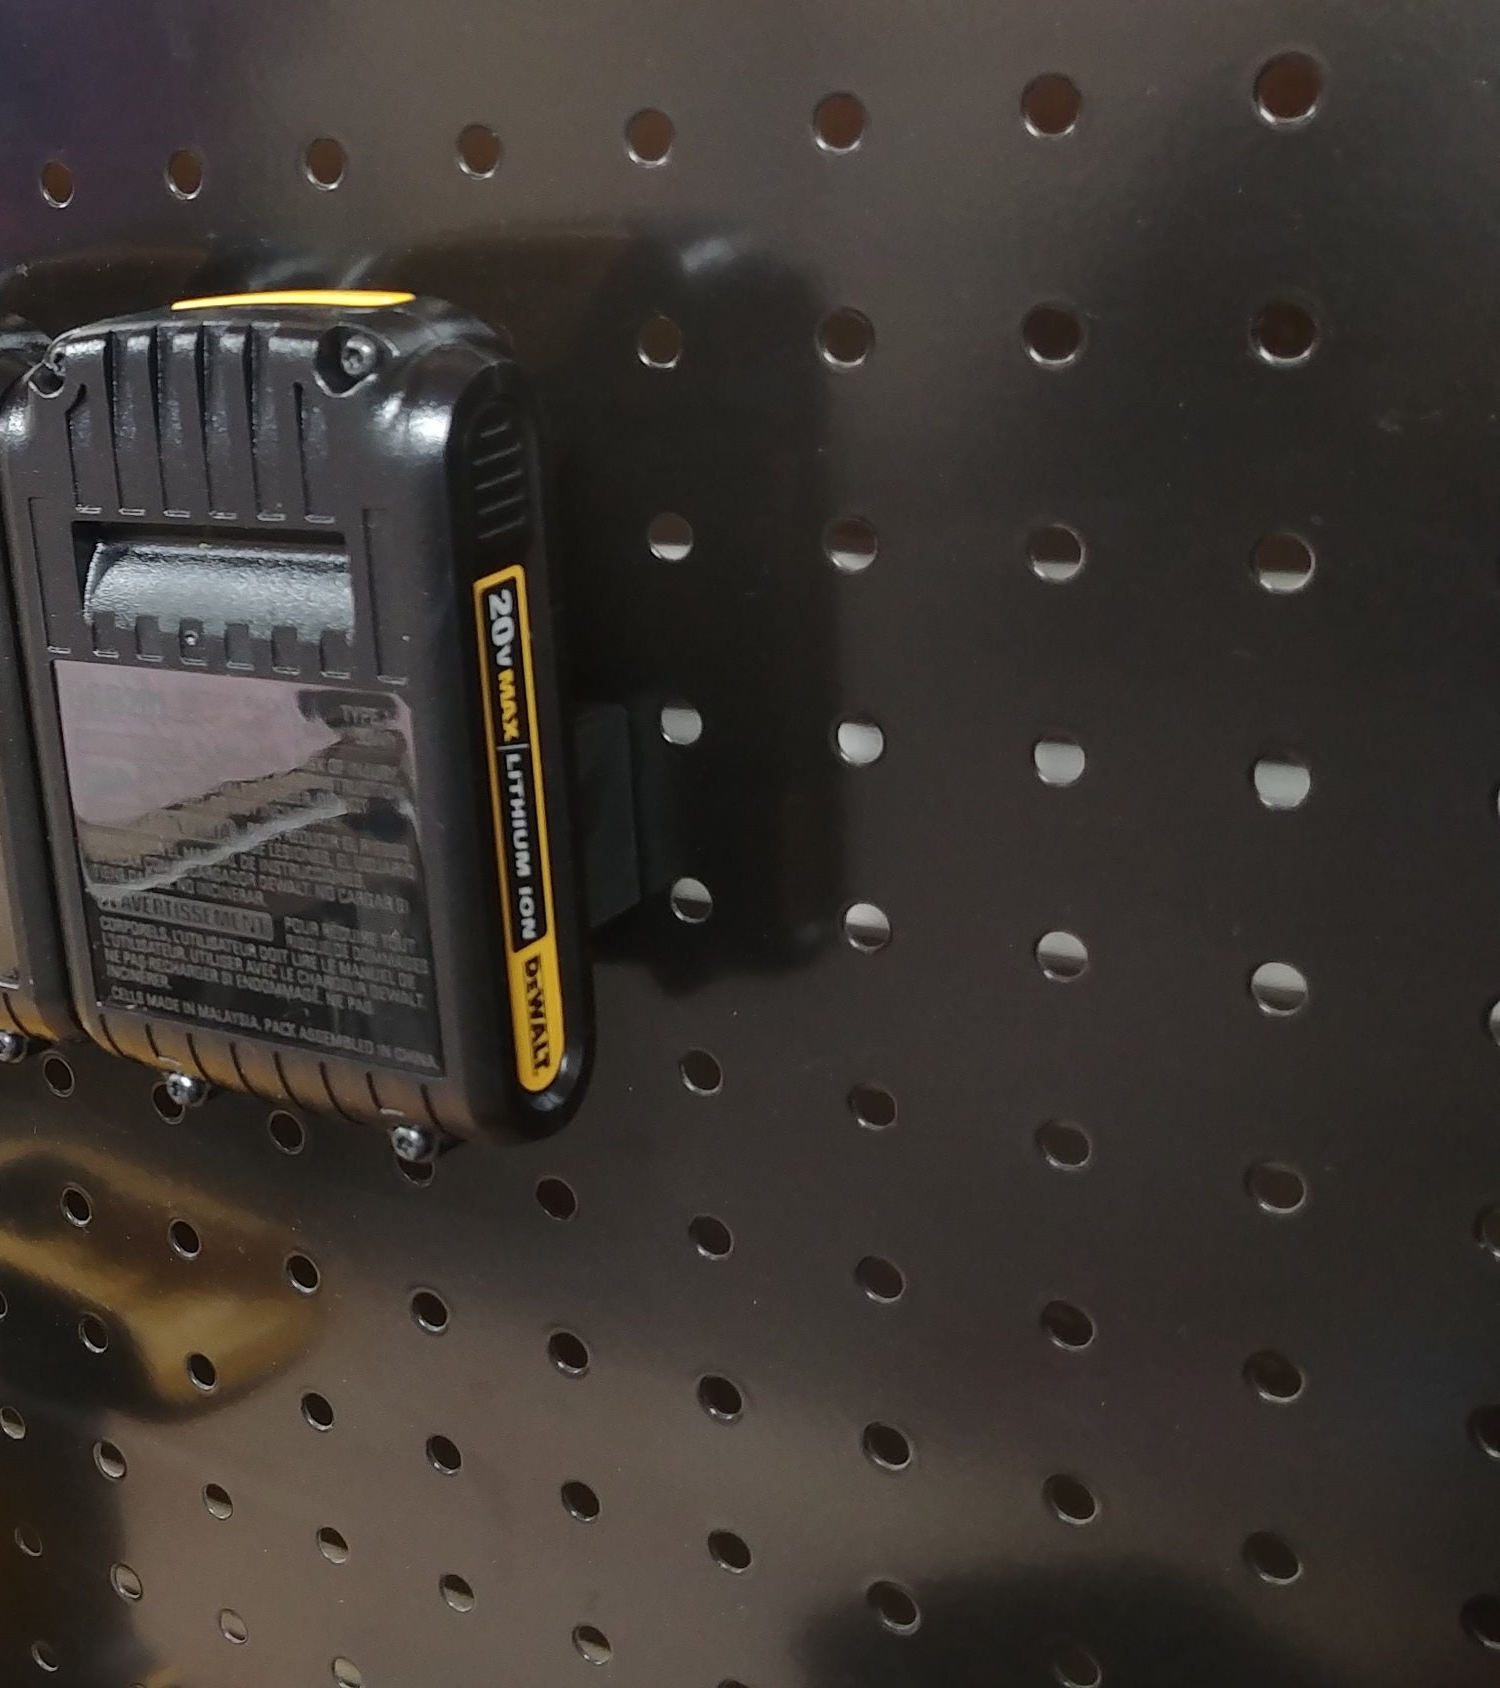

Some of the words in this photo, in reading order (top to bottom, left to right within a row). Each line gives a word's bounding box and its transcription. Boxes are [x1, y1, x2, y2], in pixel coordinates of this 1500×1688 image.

[498, 668, 519, 742] MAX
[505, 753, 532, 878] LITHIUM
[284, 916, 319, 936] POUR
[518, 886, 537, 940] ION
[146, 992, 180, 1013] MADE
[182, 1000, 196, 1016] IN
[263, 1017, 296, 1037] PACK
